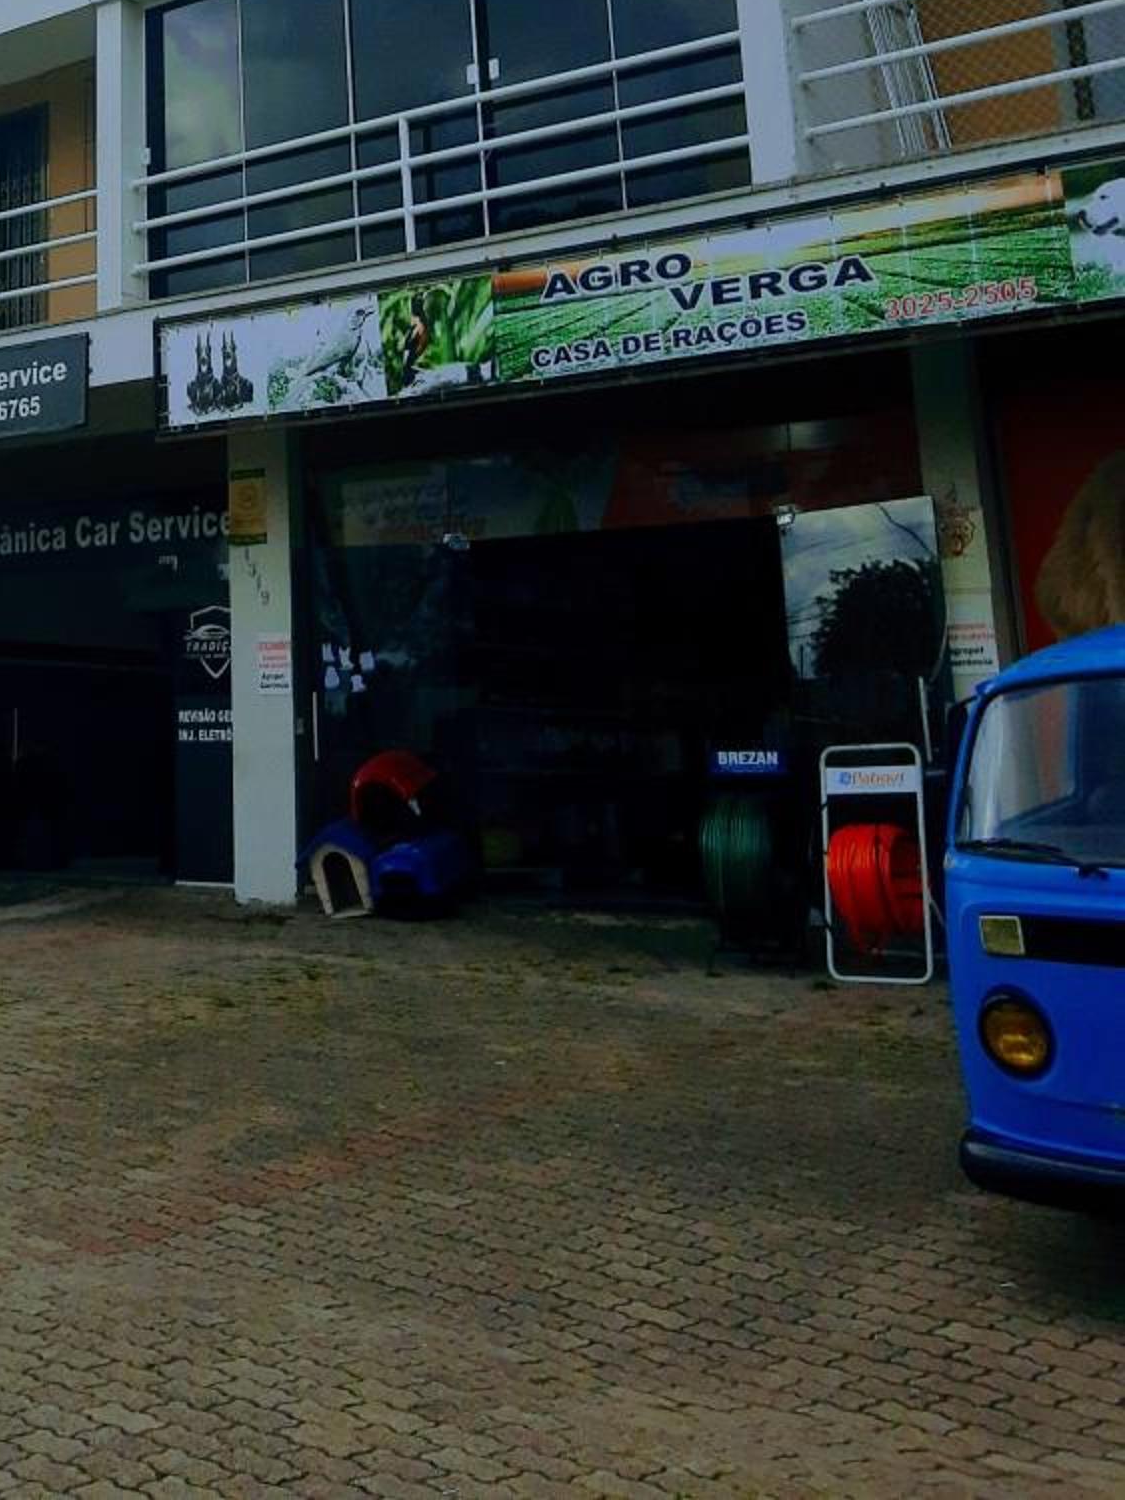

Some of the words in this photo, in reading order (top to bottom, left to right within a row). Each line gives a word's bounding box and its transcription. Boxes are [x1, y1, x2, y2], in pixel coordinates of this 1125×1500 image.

[541, 253, 692, 300] AGRO
[671, 257, 874, 311] VERGA
[885, 277, 1037, 320] 3025-2505
[532, 339, 613, 368] CASA
[623, 330, 661, 356] DE
[673, 312, 807, 348] RAÇÕES
[74, 514, 121, 548] Car
[127, 504, 229, 544] Service
[717, 750, 779, 765] BREZAN
